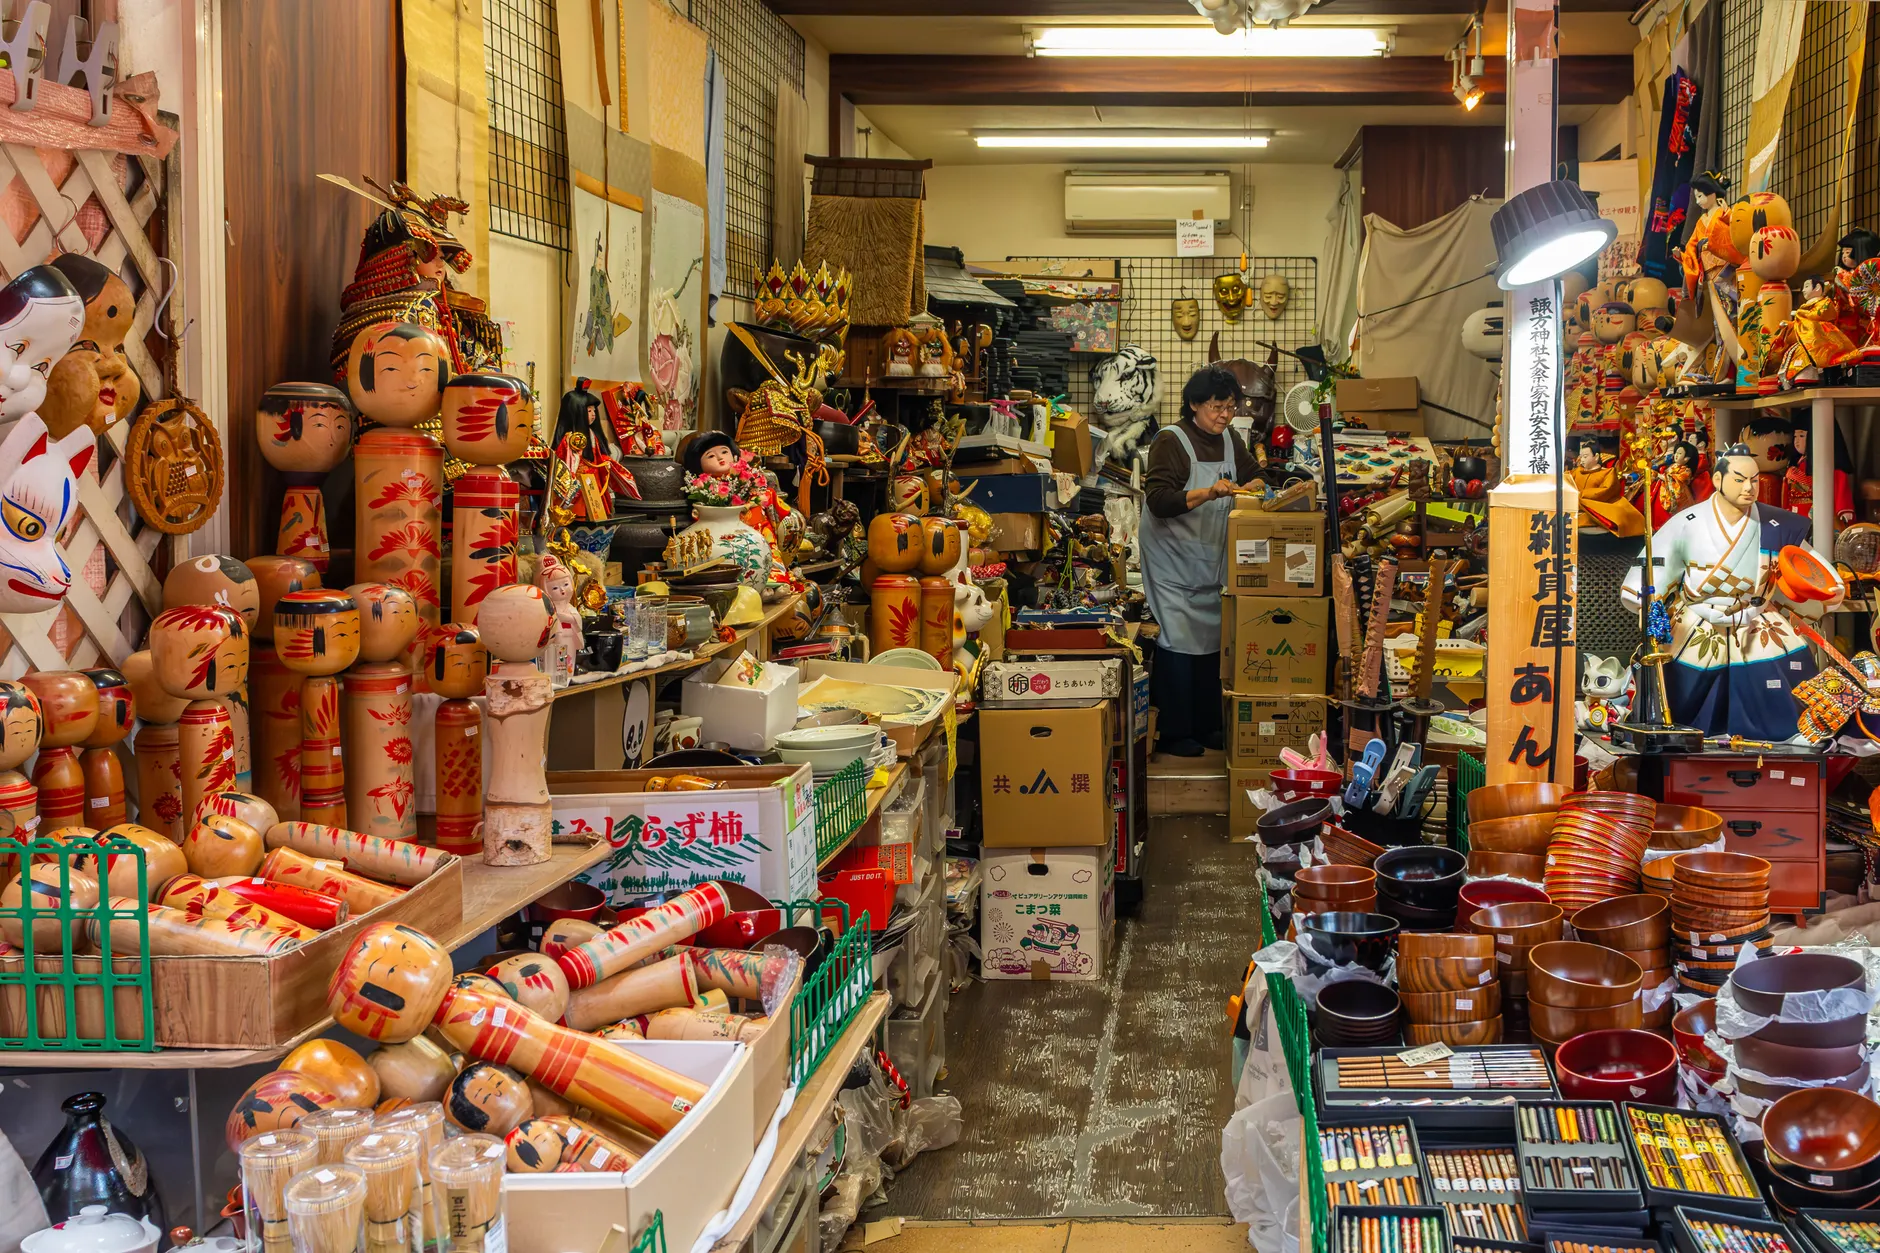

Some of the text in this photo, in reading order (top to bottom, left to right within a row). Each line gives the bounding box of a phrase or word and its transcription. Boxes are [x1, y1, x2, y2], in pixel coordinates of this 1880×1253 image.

[1508, 510, 1575, 768] 雑貨屋 あん
[1054, 680, 1096, 688] とちあいか
[1295, 725, 1301, 733] L
[993, 774, 1011, 795] 共
[1015, 904, 1062, 916] こまつ菜
